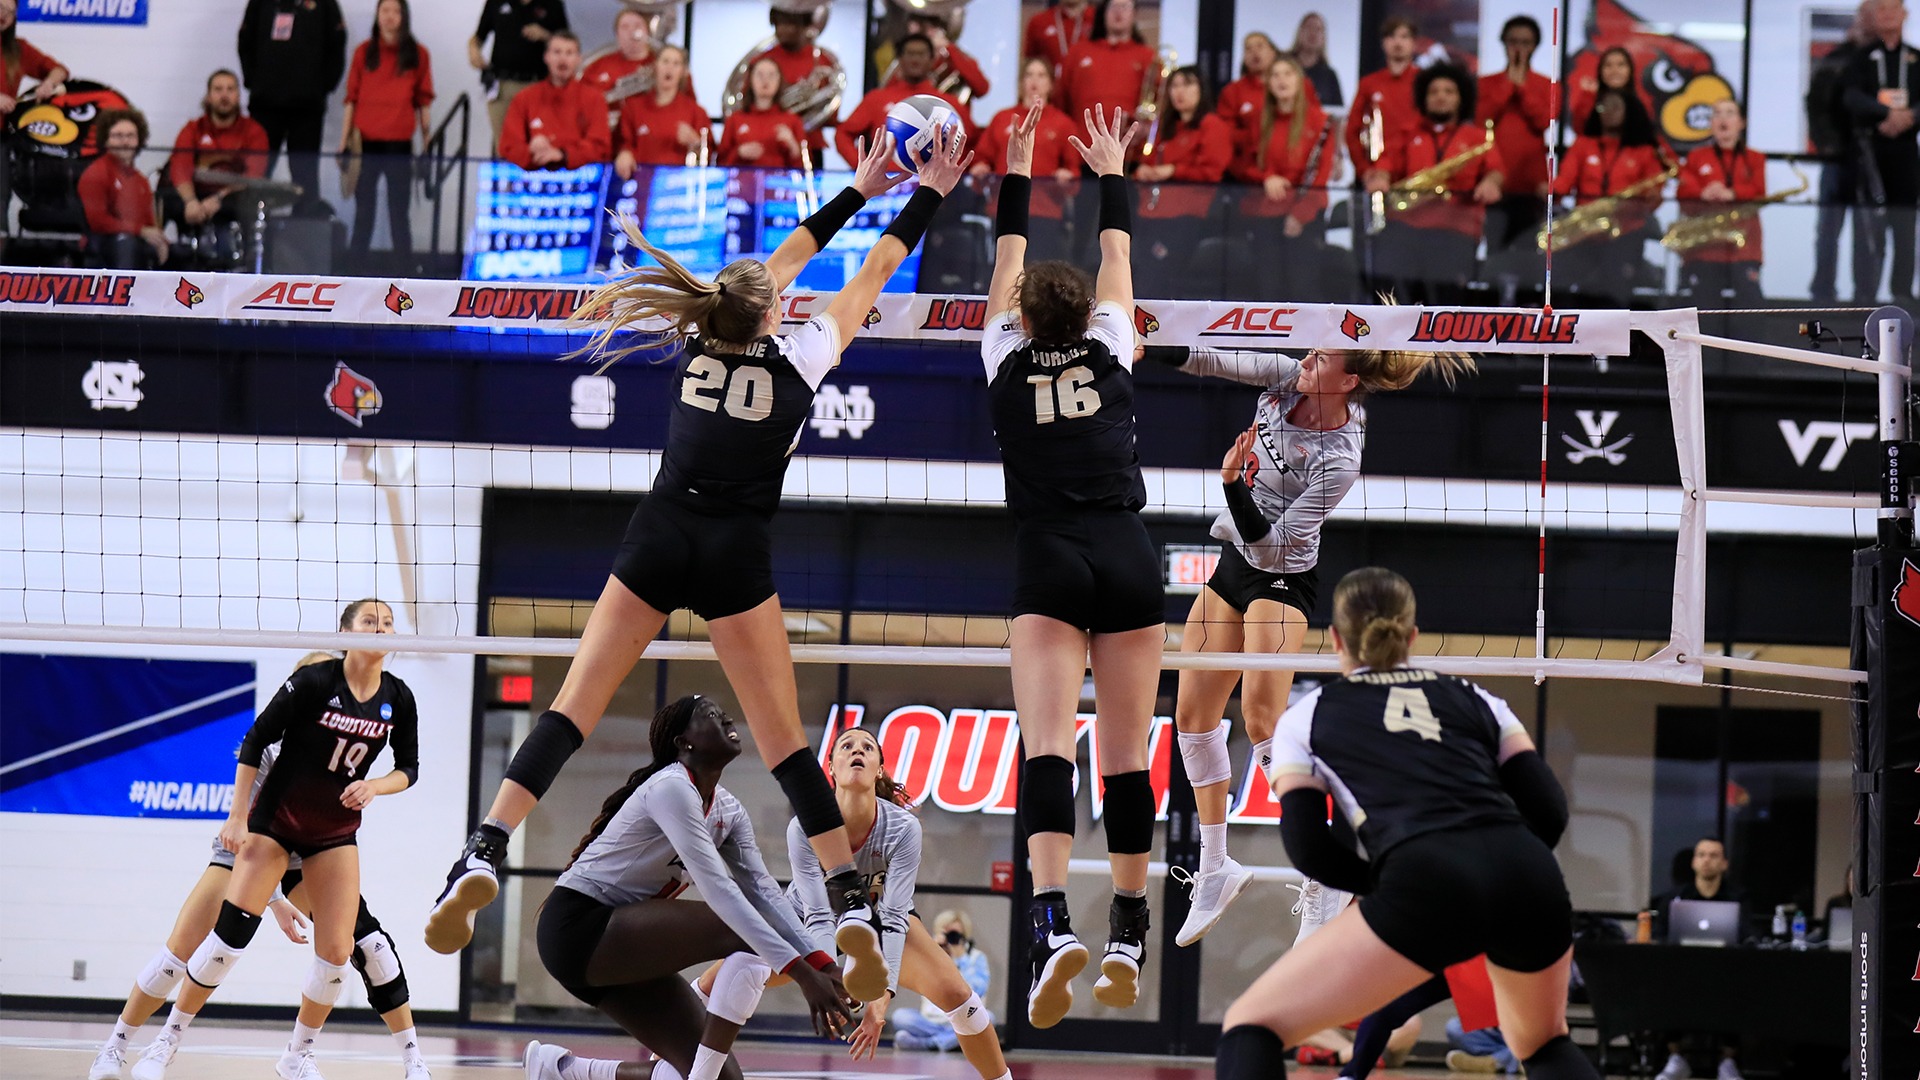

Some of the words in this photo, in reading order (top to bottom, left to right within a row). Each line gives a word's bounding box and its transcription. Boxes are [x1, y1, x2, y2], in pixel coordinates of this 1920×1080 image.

[250, 282, 342, 306] ACC
[1206, 308, 1299, 331] ACC
[1408, 311, 1580, 345] LOUISVILLE
[681, 354, 774, 422] 20
[1027, 365, 1102, 425] 16
[1778, 420, 1878, 471] VT
[1889, 458, 1899, 502] senoh
[1383, 686, 1443, 743] 4
[328, 736, 369, 777] 19
[1860, 932, 1868, 1000] sports
[1860, 1005, 1868, 1080] import
